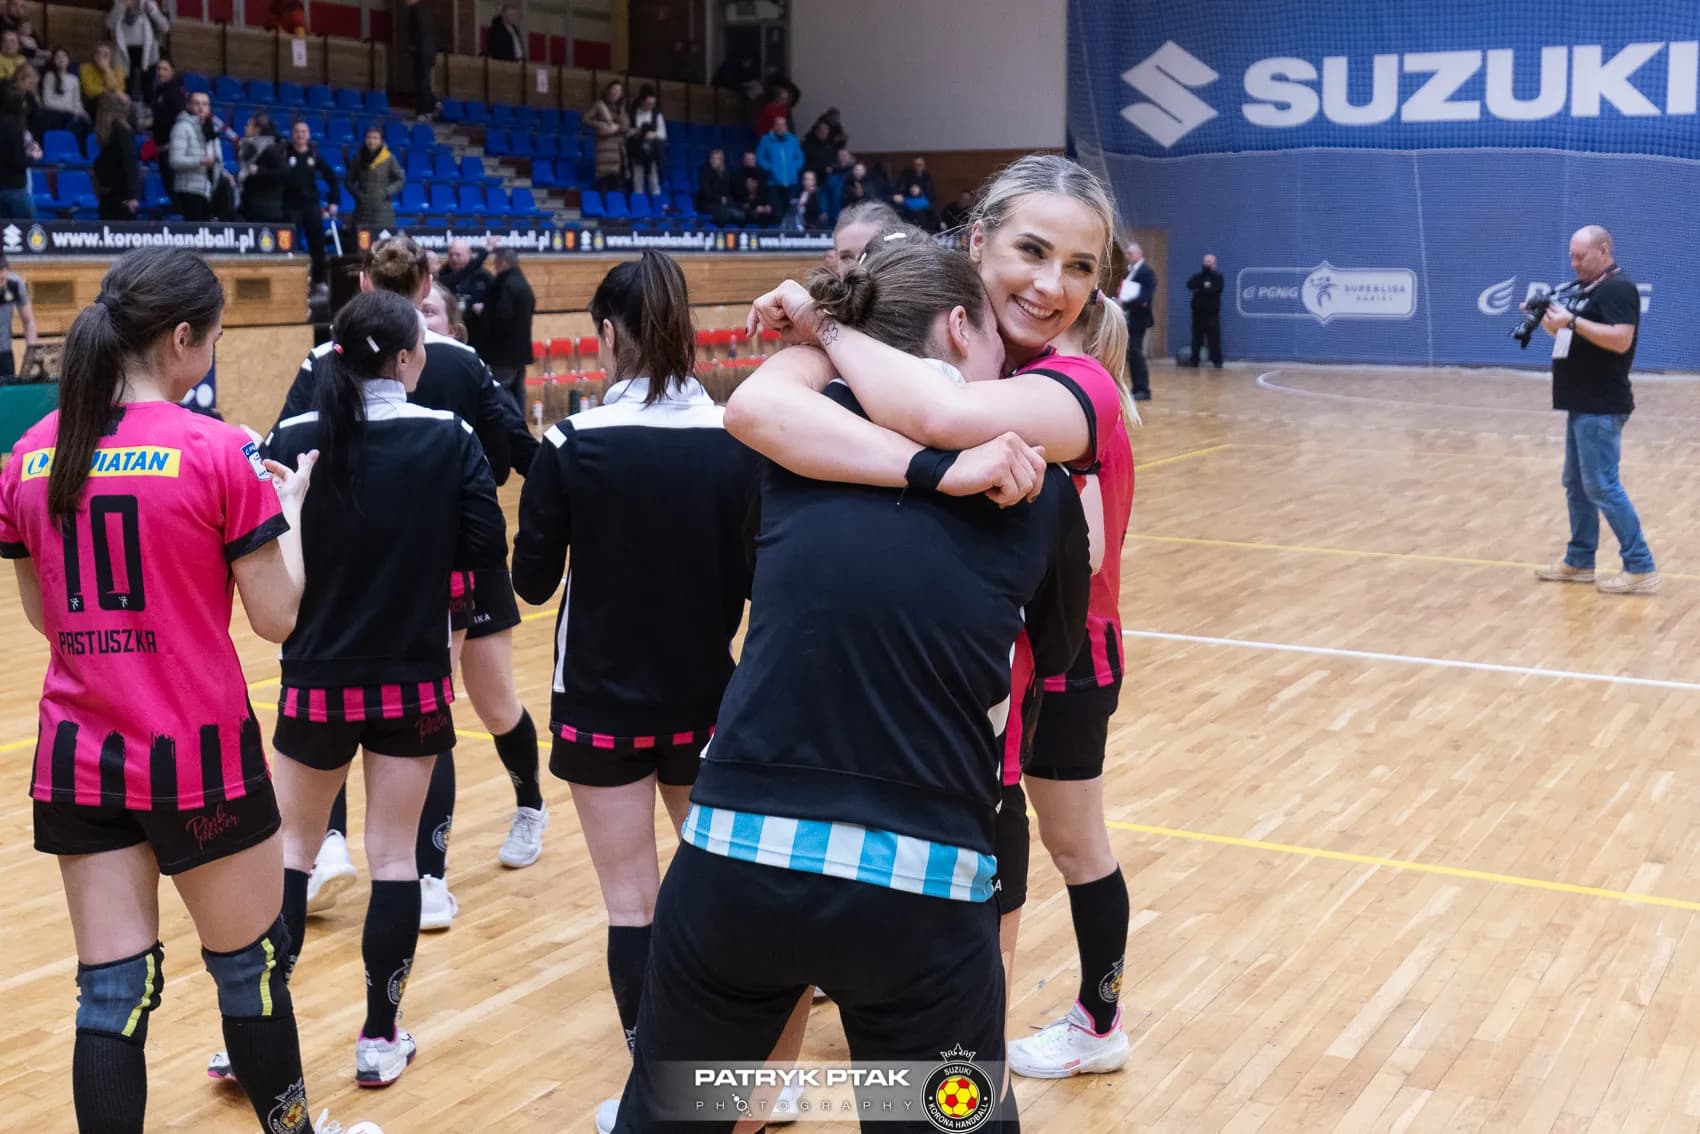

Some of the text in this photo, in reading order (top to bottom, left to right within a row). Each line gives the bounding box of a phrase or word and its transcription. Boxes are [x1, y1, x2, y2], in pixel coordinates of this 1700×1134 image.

[1241, 41, 1698, 128] SUZUKI
[52, 225, 254, 253] www.koronahandball.pl
[61, 494, 146, 612] 10
[58, 629, 158, 655] PASTUSZKA
